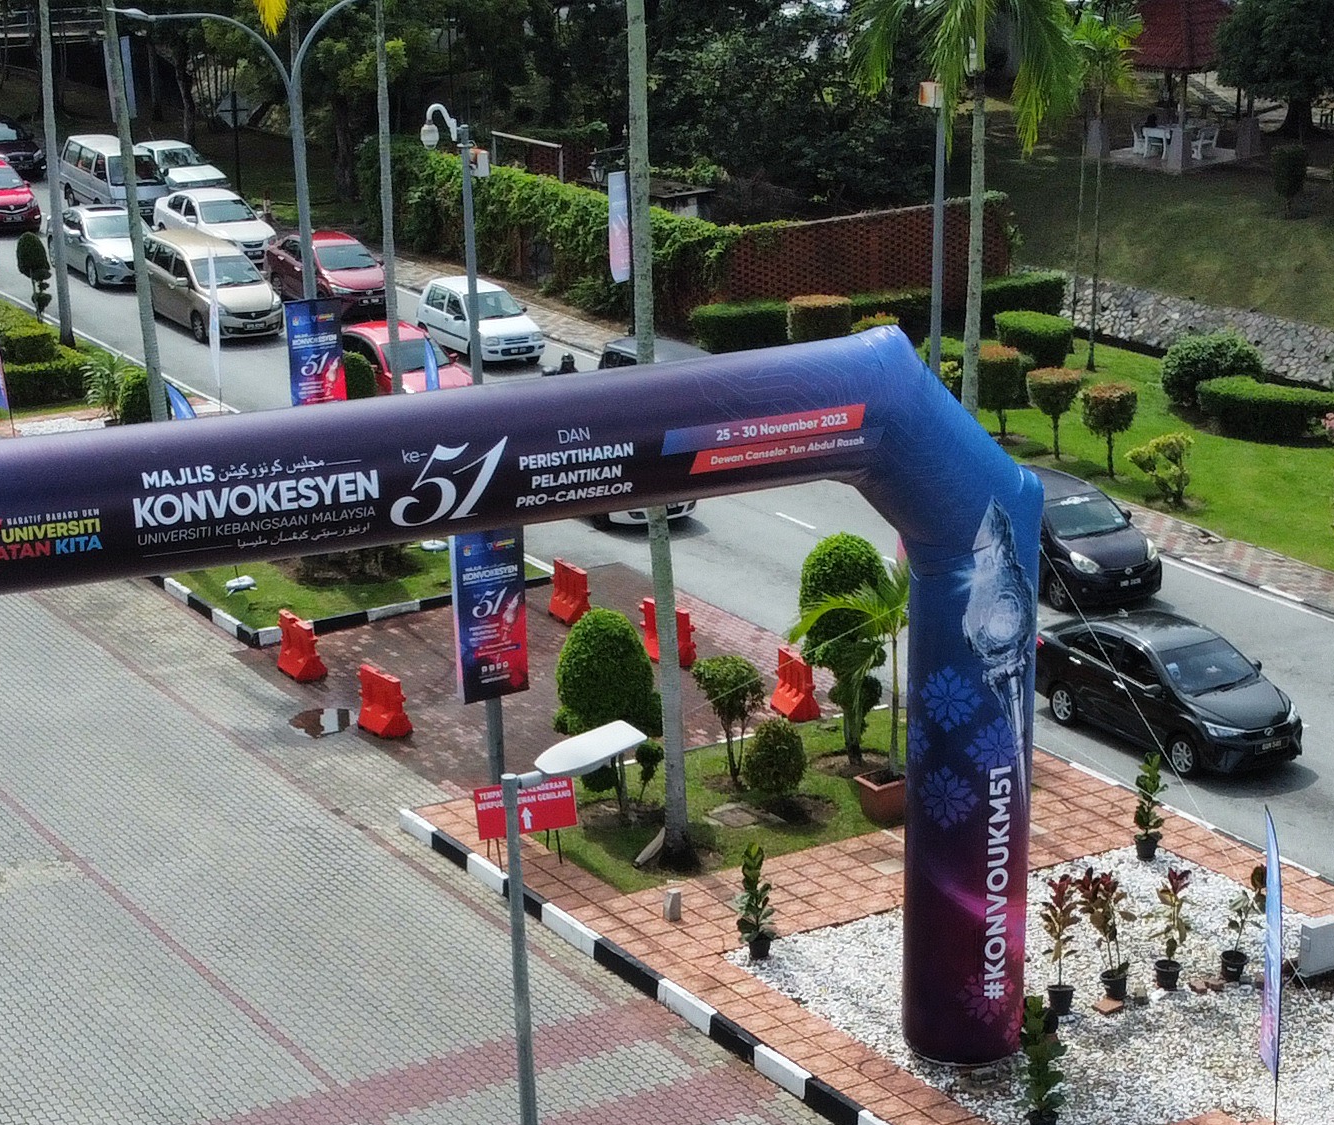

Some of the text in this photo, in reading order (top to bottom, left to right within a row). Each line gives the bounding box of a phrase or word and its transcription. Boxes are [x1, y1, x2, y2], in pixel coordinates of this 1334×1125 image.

[301, 351, 330, 376] 51
[557, 426, 591, 444] DAN
[716, 429, 730, 442] 25
[742, 426, 758, 438] 30
[760, 418, 818, 435] November
[820, 413, 848, 428] 2023
[519, 442, 634, 470] PERISYTIHARAN
[710, 435, 865, 466] Dewan Canselor Tun Abdul Razak
[141, 464, 215, 489] MAJLIS
[390, 435, 508, 527] 51
[531, 464, 622, 489] PELANTIKAN
[132, 469, 379, 528] KONVOKESYEN
[516, 482, 633, 508] PRO-CANSELOR
[1, 518, 101, 544] UNIVERSITI
[137, 506, 376, 546] UNIVERSITI KEBANGSAAN MALAYSIA
[55, 534, 103, 555] KITA
[472, 586, 508, 619] 51
[517, 794, 537, 805] EWAN
[983, 764, 1013, 1000] #KONVOUKM51
